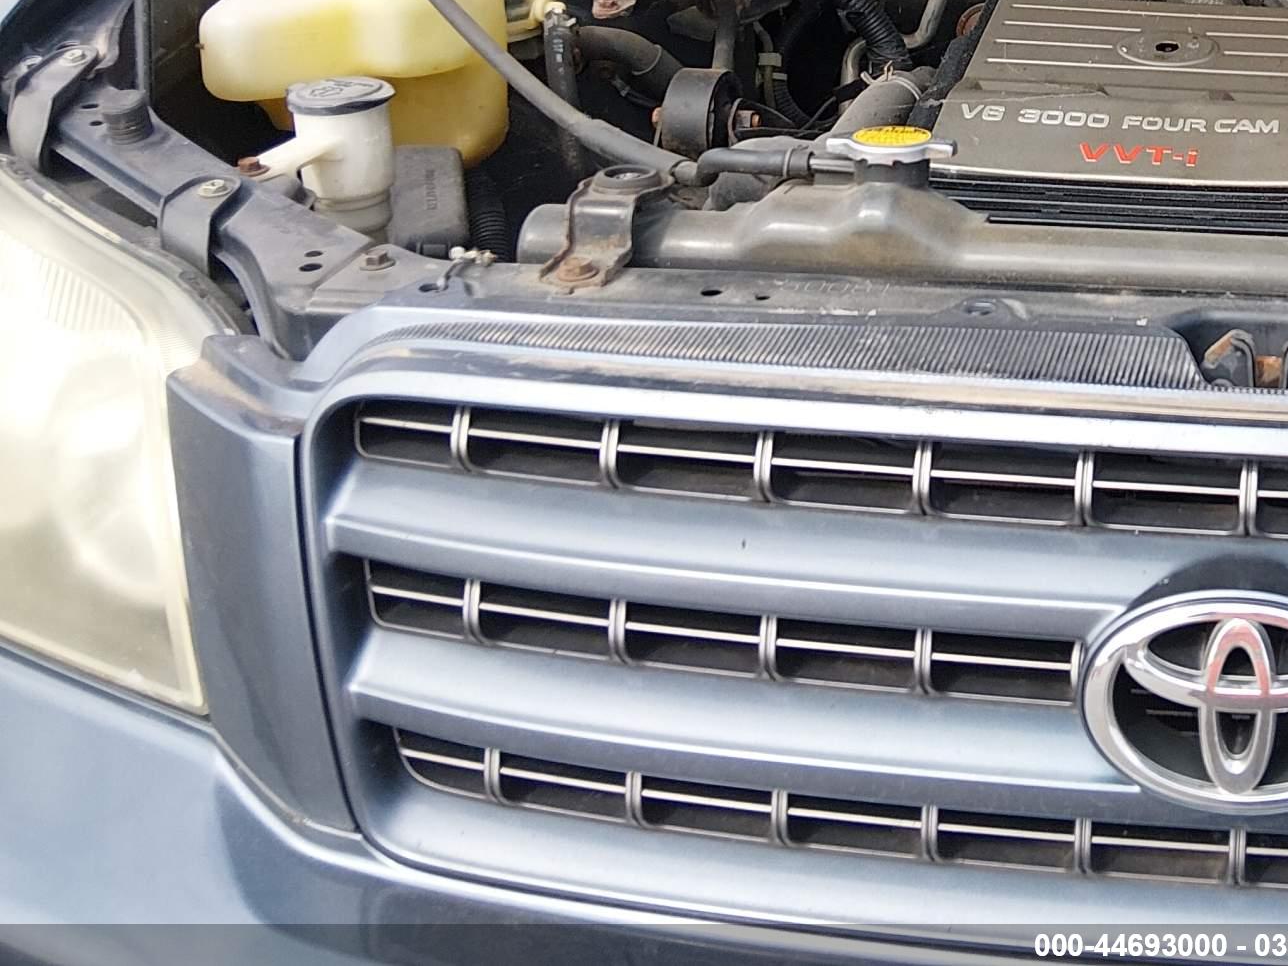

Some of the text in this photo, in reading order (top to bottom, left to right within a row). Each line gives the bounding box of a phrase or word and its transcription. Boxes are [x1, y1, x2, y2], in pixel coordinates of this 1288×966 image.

[960, 101, 1006, 122] V6
[1018, 107, 1111, 129] 3000
[1122, 114, 1208, 134] FOUR
[1213, 118, 1280, 136] CAM
[1079, 143, 1199, 168] VVT-i
